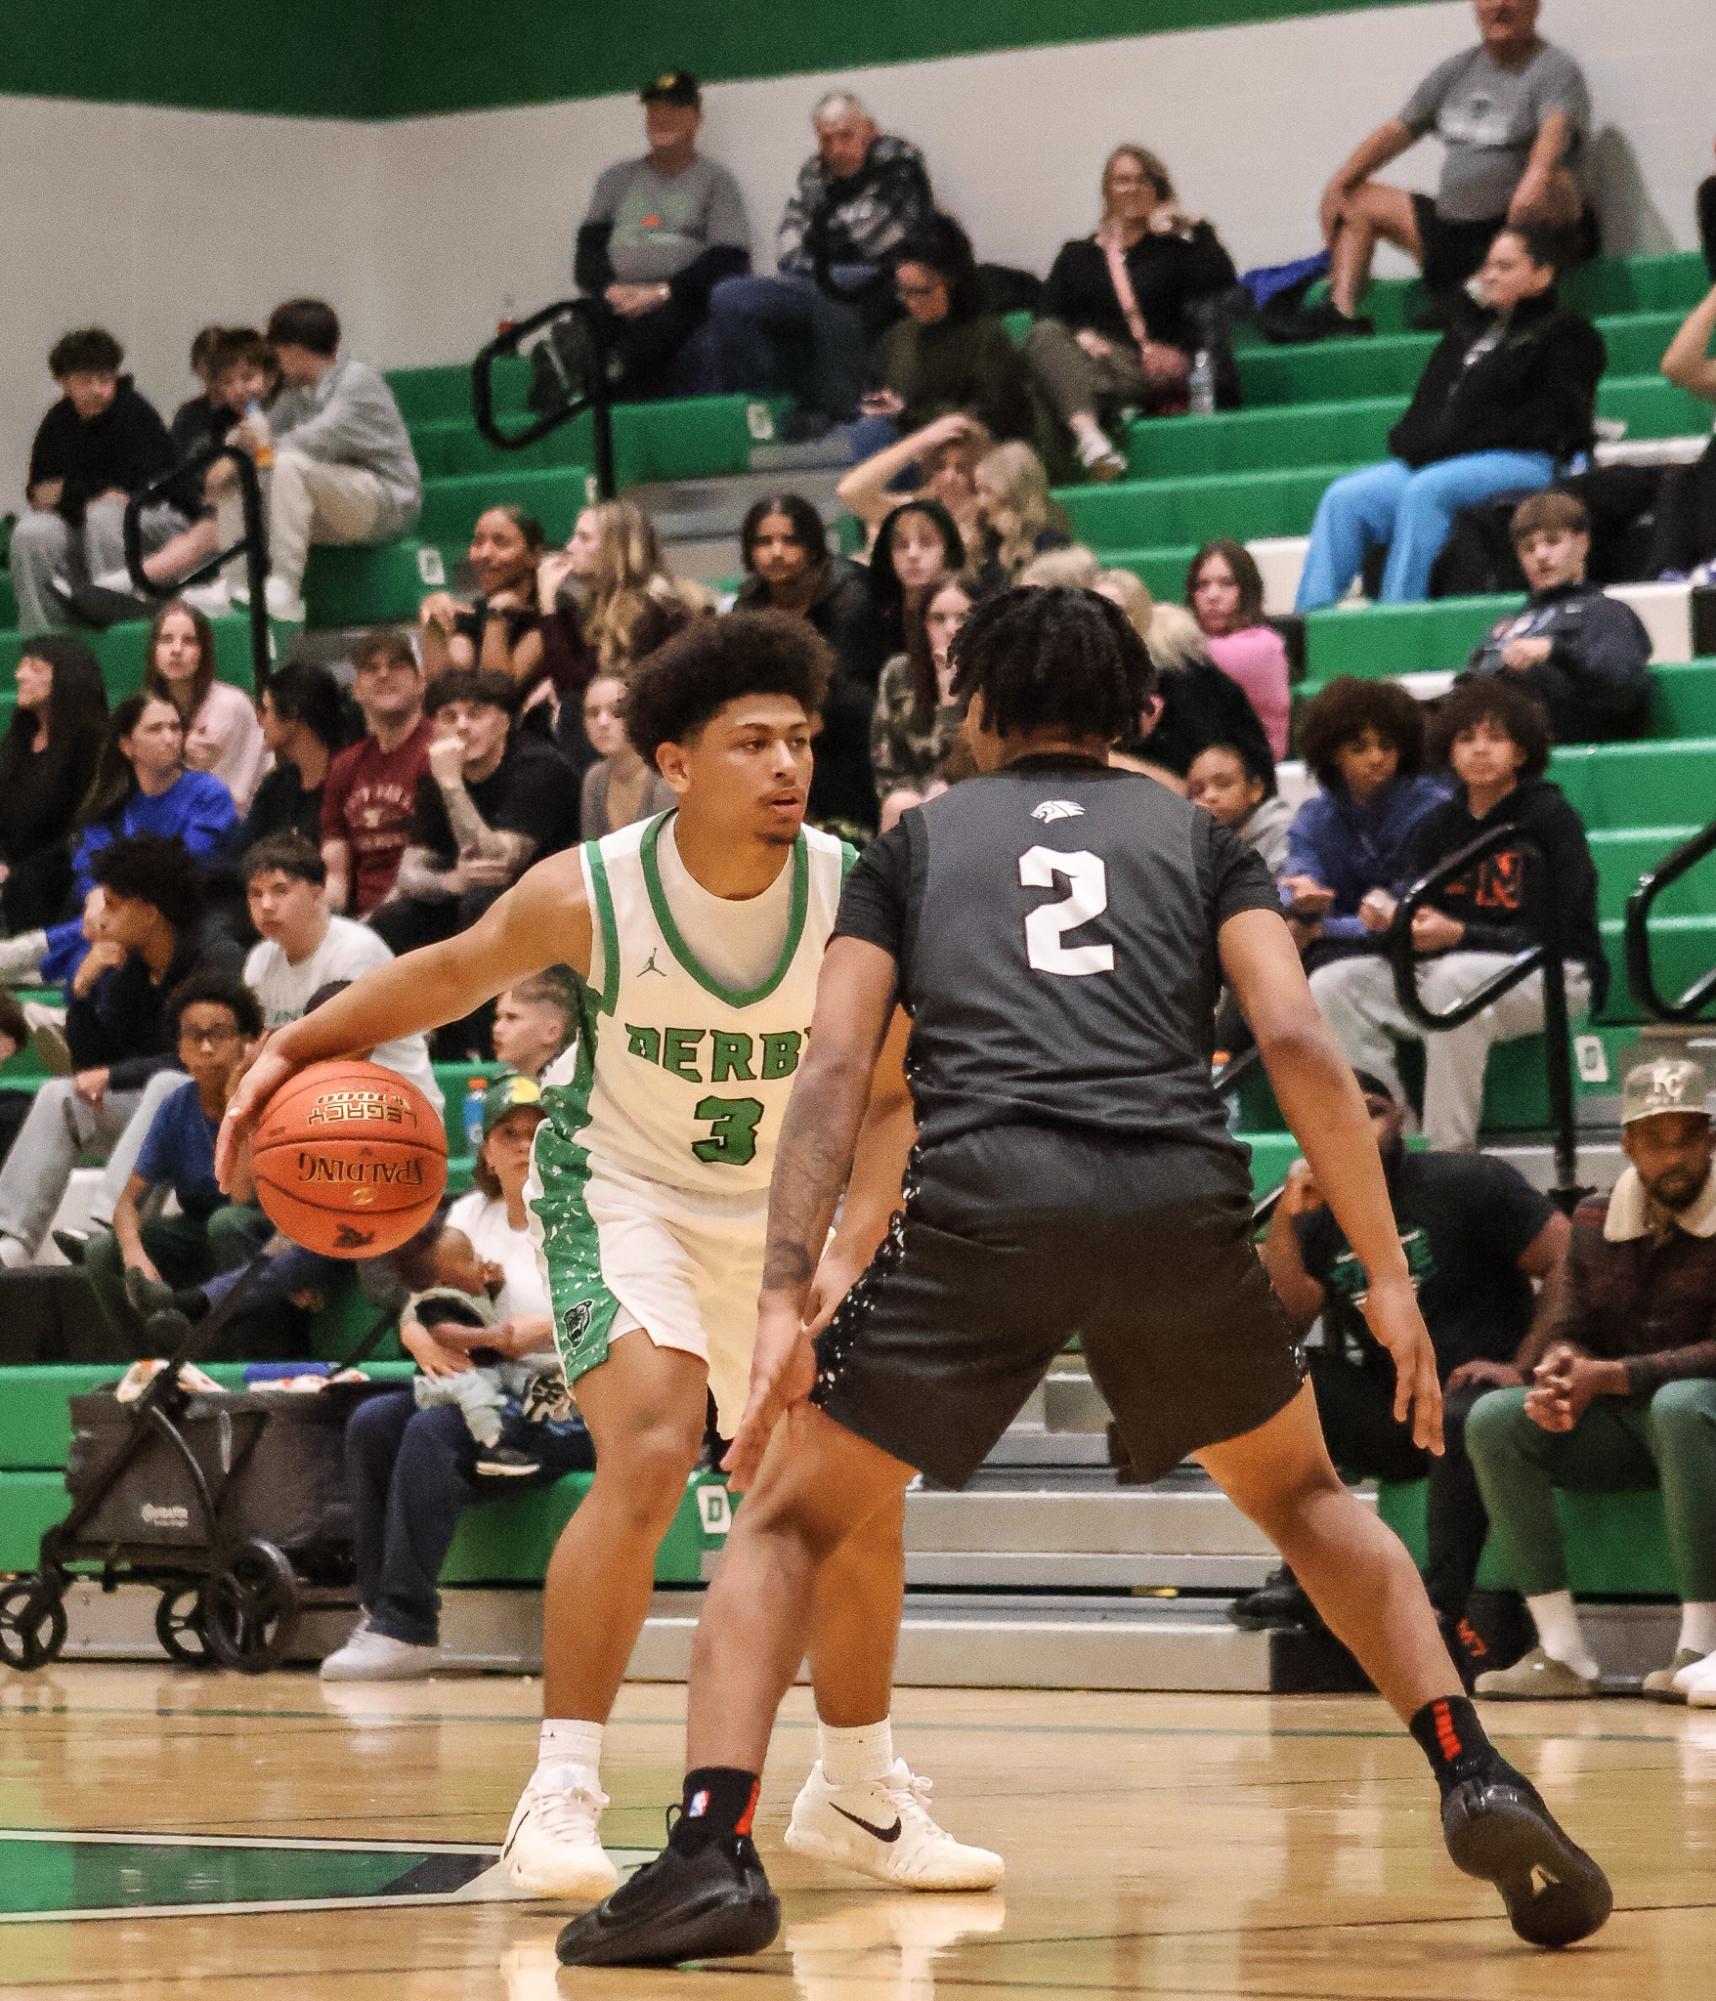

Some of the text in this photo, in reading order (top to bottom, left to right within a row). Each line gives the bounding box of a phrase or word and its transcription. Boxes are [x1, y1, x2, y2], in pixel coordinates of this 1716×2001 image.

[1018, 845, 1115, 977] 2
[625, 1022, 812, 1084] DERB
[307, 1100, 418, 1130] LEGACY
[691, 1095, 765, 1166] 3
[297, 1151, 425, 1186] SPALDING
